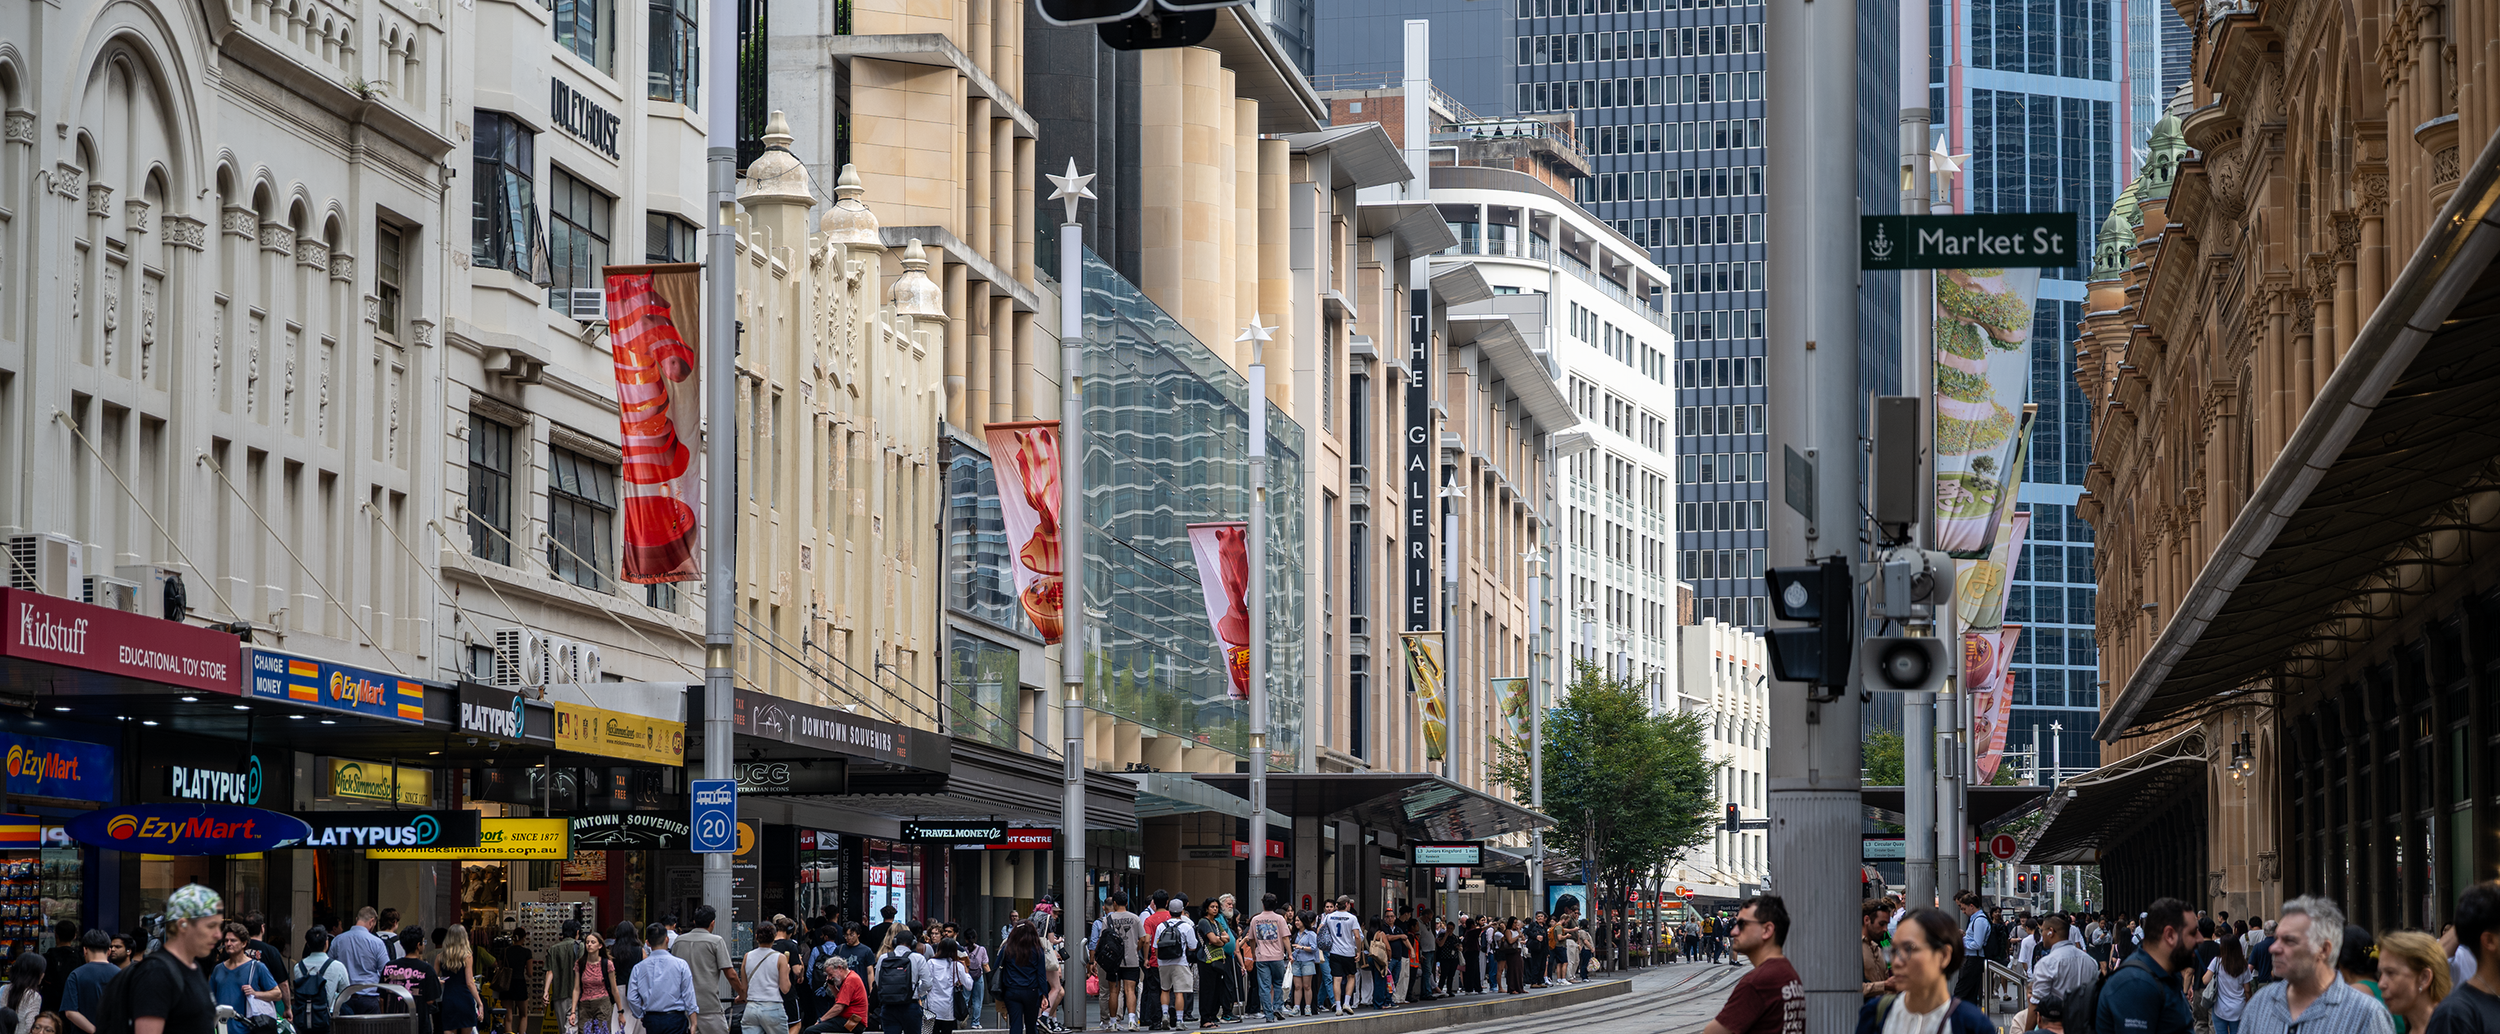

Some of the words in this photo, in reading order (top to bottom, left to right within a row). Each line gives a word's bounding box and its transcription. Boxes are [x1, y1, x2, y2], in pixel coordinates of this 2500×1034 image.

[1917, 227, 2024, 255] Market
[2032, 227, 2064, 255] St
[1411, 315, 1425, 388] THE
[627, 571, 653, 579] Knights
[19, 602, 89, 655] Kidstuff
[119, 645, 181, 674] EDUCATIONAL
[182, 657, 199, 677] TOY
[200, 661, 227, 681] STORE
[254, 654, 284, 674] CHANGE
[256, 676, 282, 695] MONEY
[342, 675, 386, 707] EzyMart
[735, 698, 745, 710] TAX
[461, 702, 516, 739] PLATYPUS
[802, 715, 847, 743] DOWNTOWN
[849, 725, 892, 753] SOUVENIRS
[897, 733, 906, 745] TAX
[896, 746, 907, 758] FREE
[22, 749, 79, 784] EzyMart
[733, 763, 790, 786] UGG
[172, 765, 247, 805] PLATYPUS
[333, 765, 353, 795] Mick
[353, 773, 383, 796] Simmons
[616, 775, 626, 786] TAX
[614, 789, 627, 800] FREE
[138, 816, 255, 844] EzyMart
[574, 813, 620, 830] WNTOWN
[626, 813, 690, 836] SOUVENIRS
[703, 819, 726, 839] 20
[919, 828, 954, 838] TRAVEL
[954, 828, 989, 838] MONEY
[989, 827, 1001, 840] Oz
[306, 826, 417, 846] LATYPUS
[510, 832, 538, 841] SINCE
[540, 832, 559, 841] 1877
[1999, 839, 2009, 854] L
[1335, 922, 1342, 937] 1
